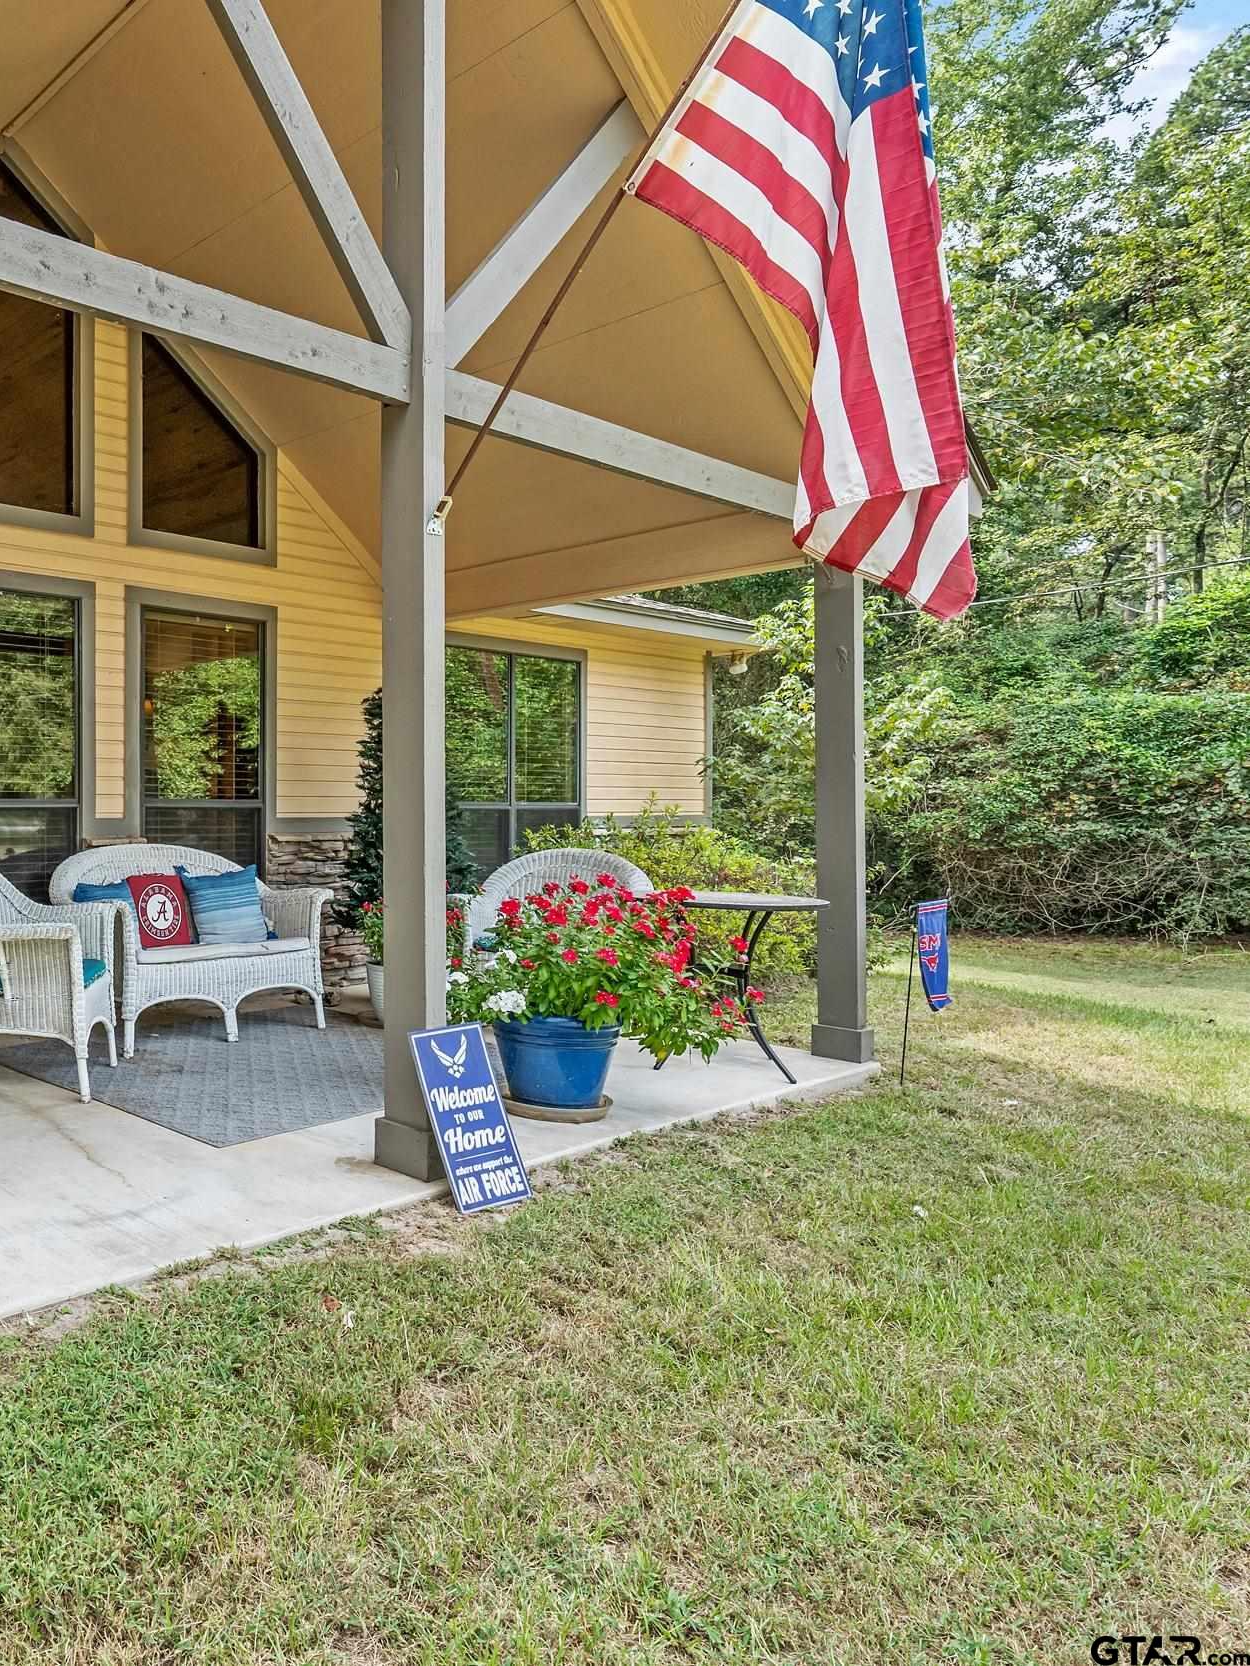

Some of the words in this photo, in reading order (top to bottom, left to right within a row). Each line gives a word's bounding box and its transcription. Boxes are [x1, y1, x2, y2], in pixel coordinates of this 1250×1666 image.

[152, 900, 170, 922] A
[430, 1084, 496, 1112] Welcome
[454, 1112, 466, 1125] TO
[467, 1109, 485, 1122] OUR
[443, 1125, 506, 1154] Home
[458, 1176, 484, 1206] AIR
[480, 1166, 525, 1199] FORCE
